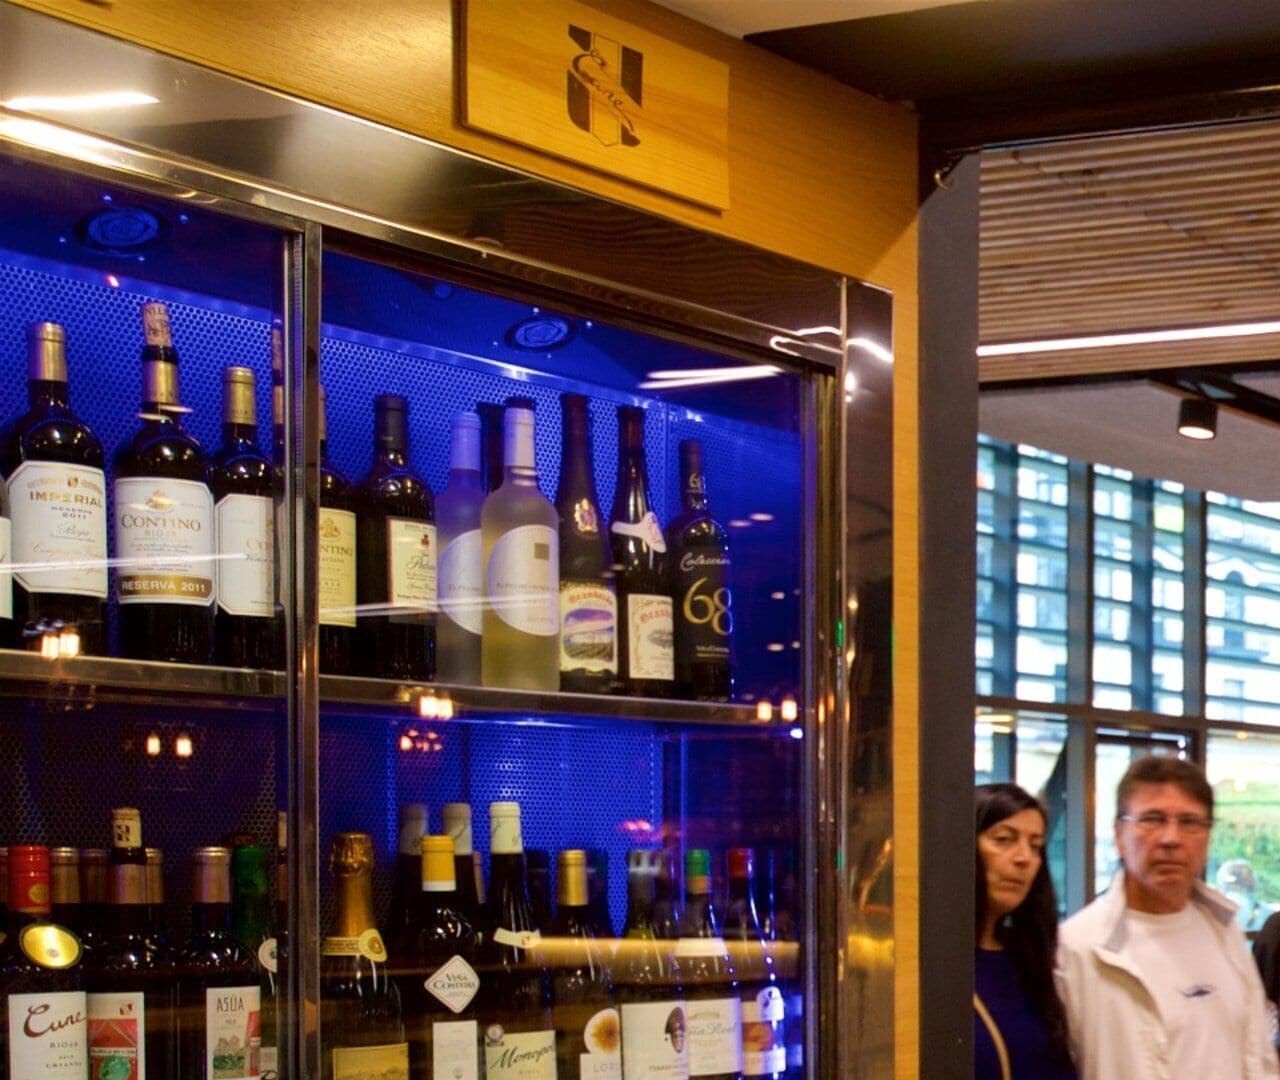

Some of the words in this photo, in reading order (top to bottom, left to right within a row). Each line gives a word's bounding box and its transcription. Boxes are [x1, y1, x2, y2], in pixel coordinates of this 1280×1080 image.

[29, 490, 103, 508] IMPERIAL
[121, 512, 201, 532] CONTINO
[121, 580, 177, 592] RESERVA
[179, 581, 205, 593] 2011
[683, 576, 734, 637] 68
[23, 1003, 88, 1039] Cune
